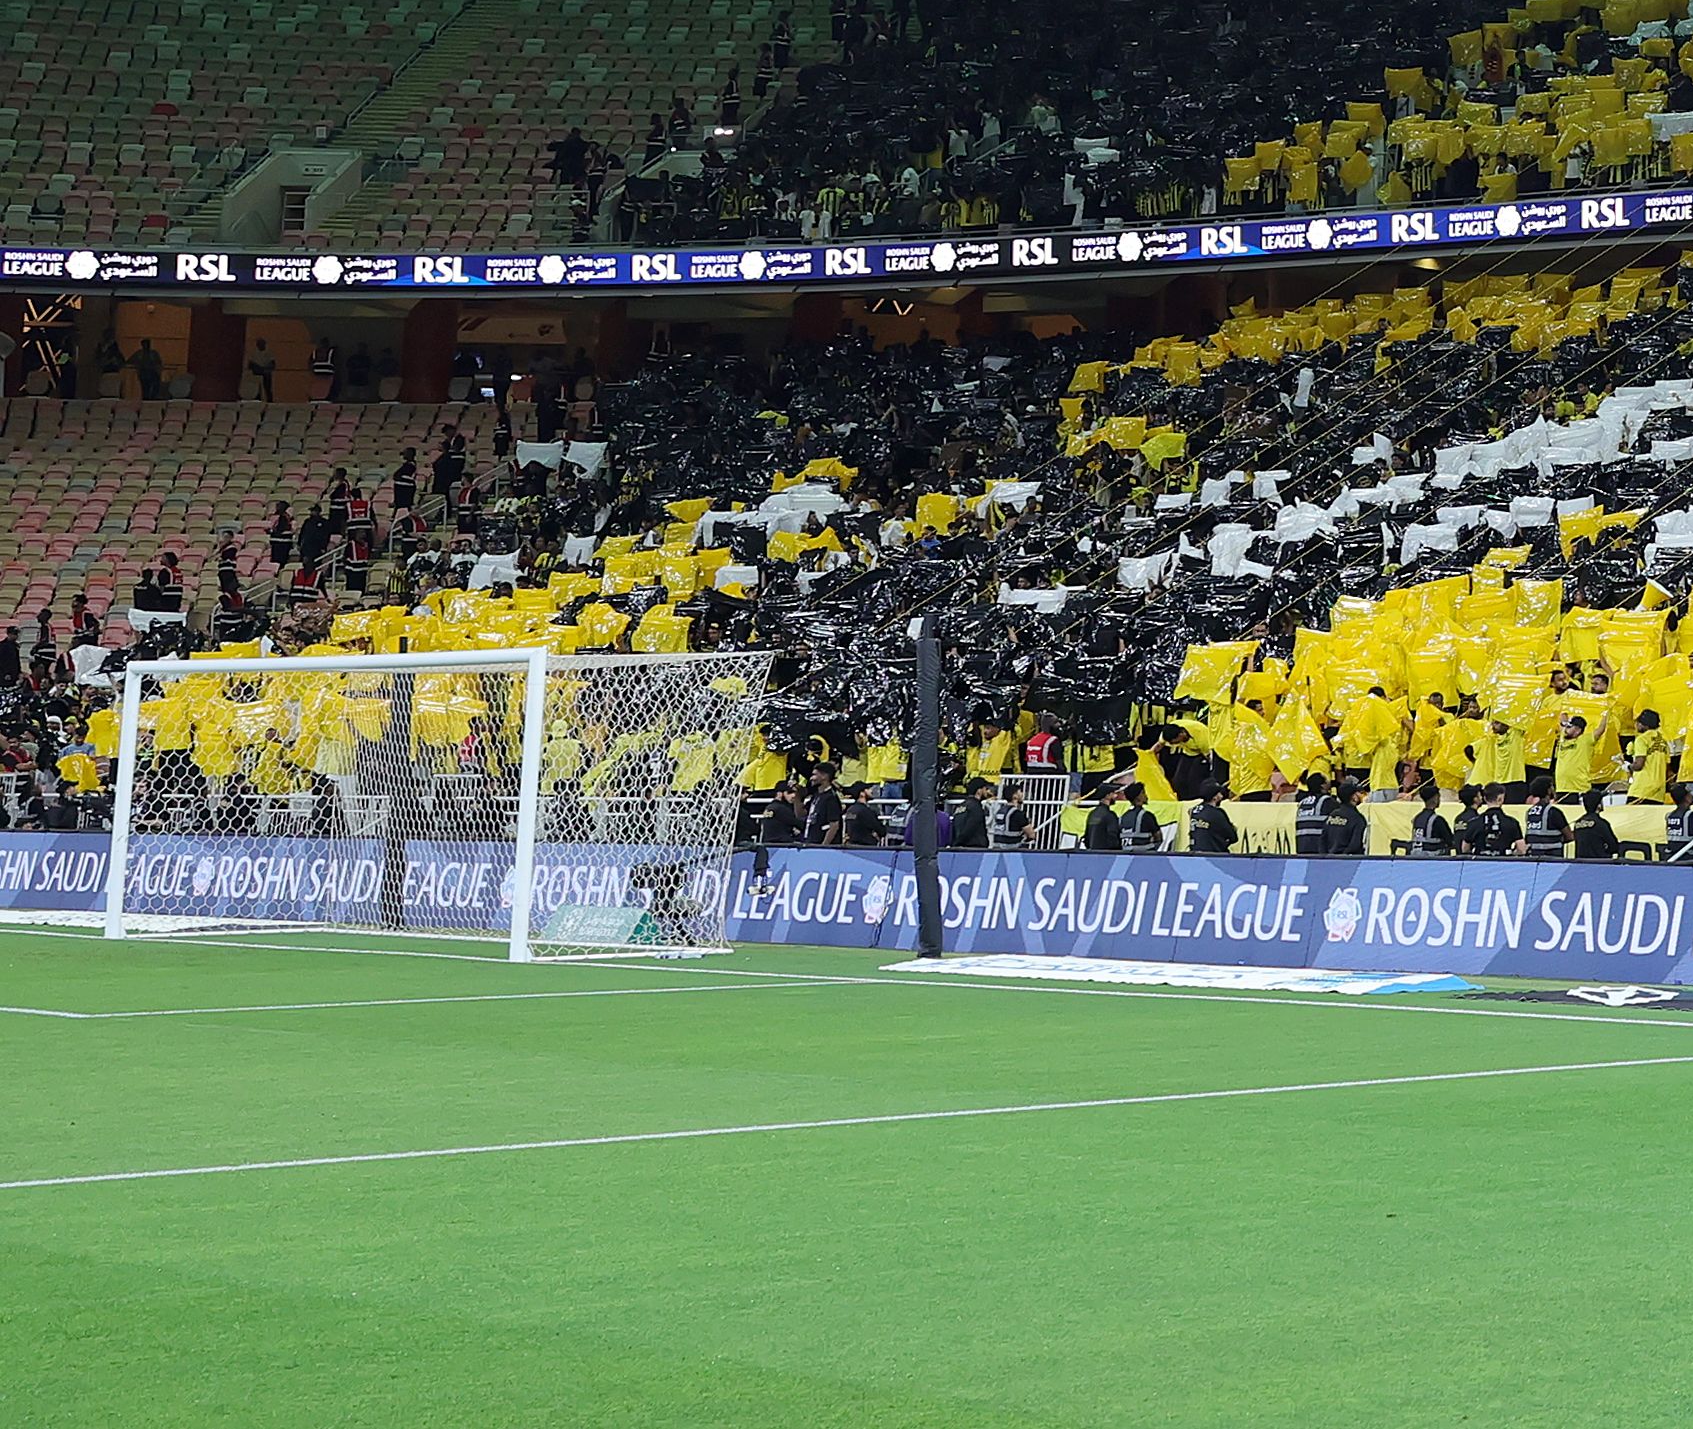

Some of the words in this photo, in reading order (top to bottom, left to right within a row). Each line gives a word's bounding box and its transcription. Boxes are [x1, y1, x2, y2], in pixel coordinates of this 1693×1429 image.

[486, 268, 536, 281] LEAGUE
[632, 254, 681, 280] RSL
[1326, 815, 1347, 826] Police
[36, 851, 108, 892] SAUDI
[106, 853, 194, 899] EAGUE
[214, 856, 304, 900] ROSHN
[305, 859, 384, 903] SAUDI
[404, 860, 493, 908] EAGUE
[733, 870, 863, 924] LEAGUE
[1028, 878, 1148, 937] SAUDI
[1153, 881, 1308, 942] LEAGUE
[1365, 886, 1527, 949] ROSHN
[1535, 890, 1682, 957] SAUDI
